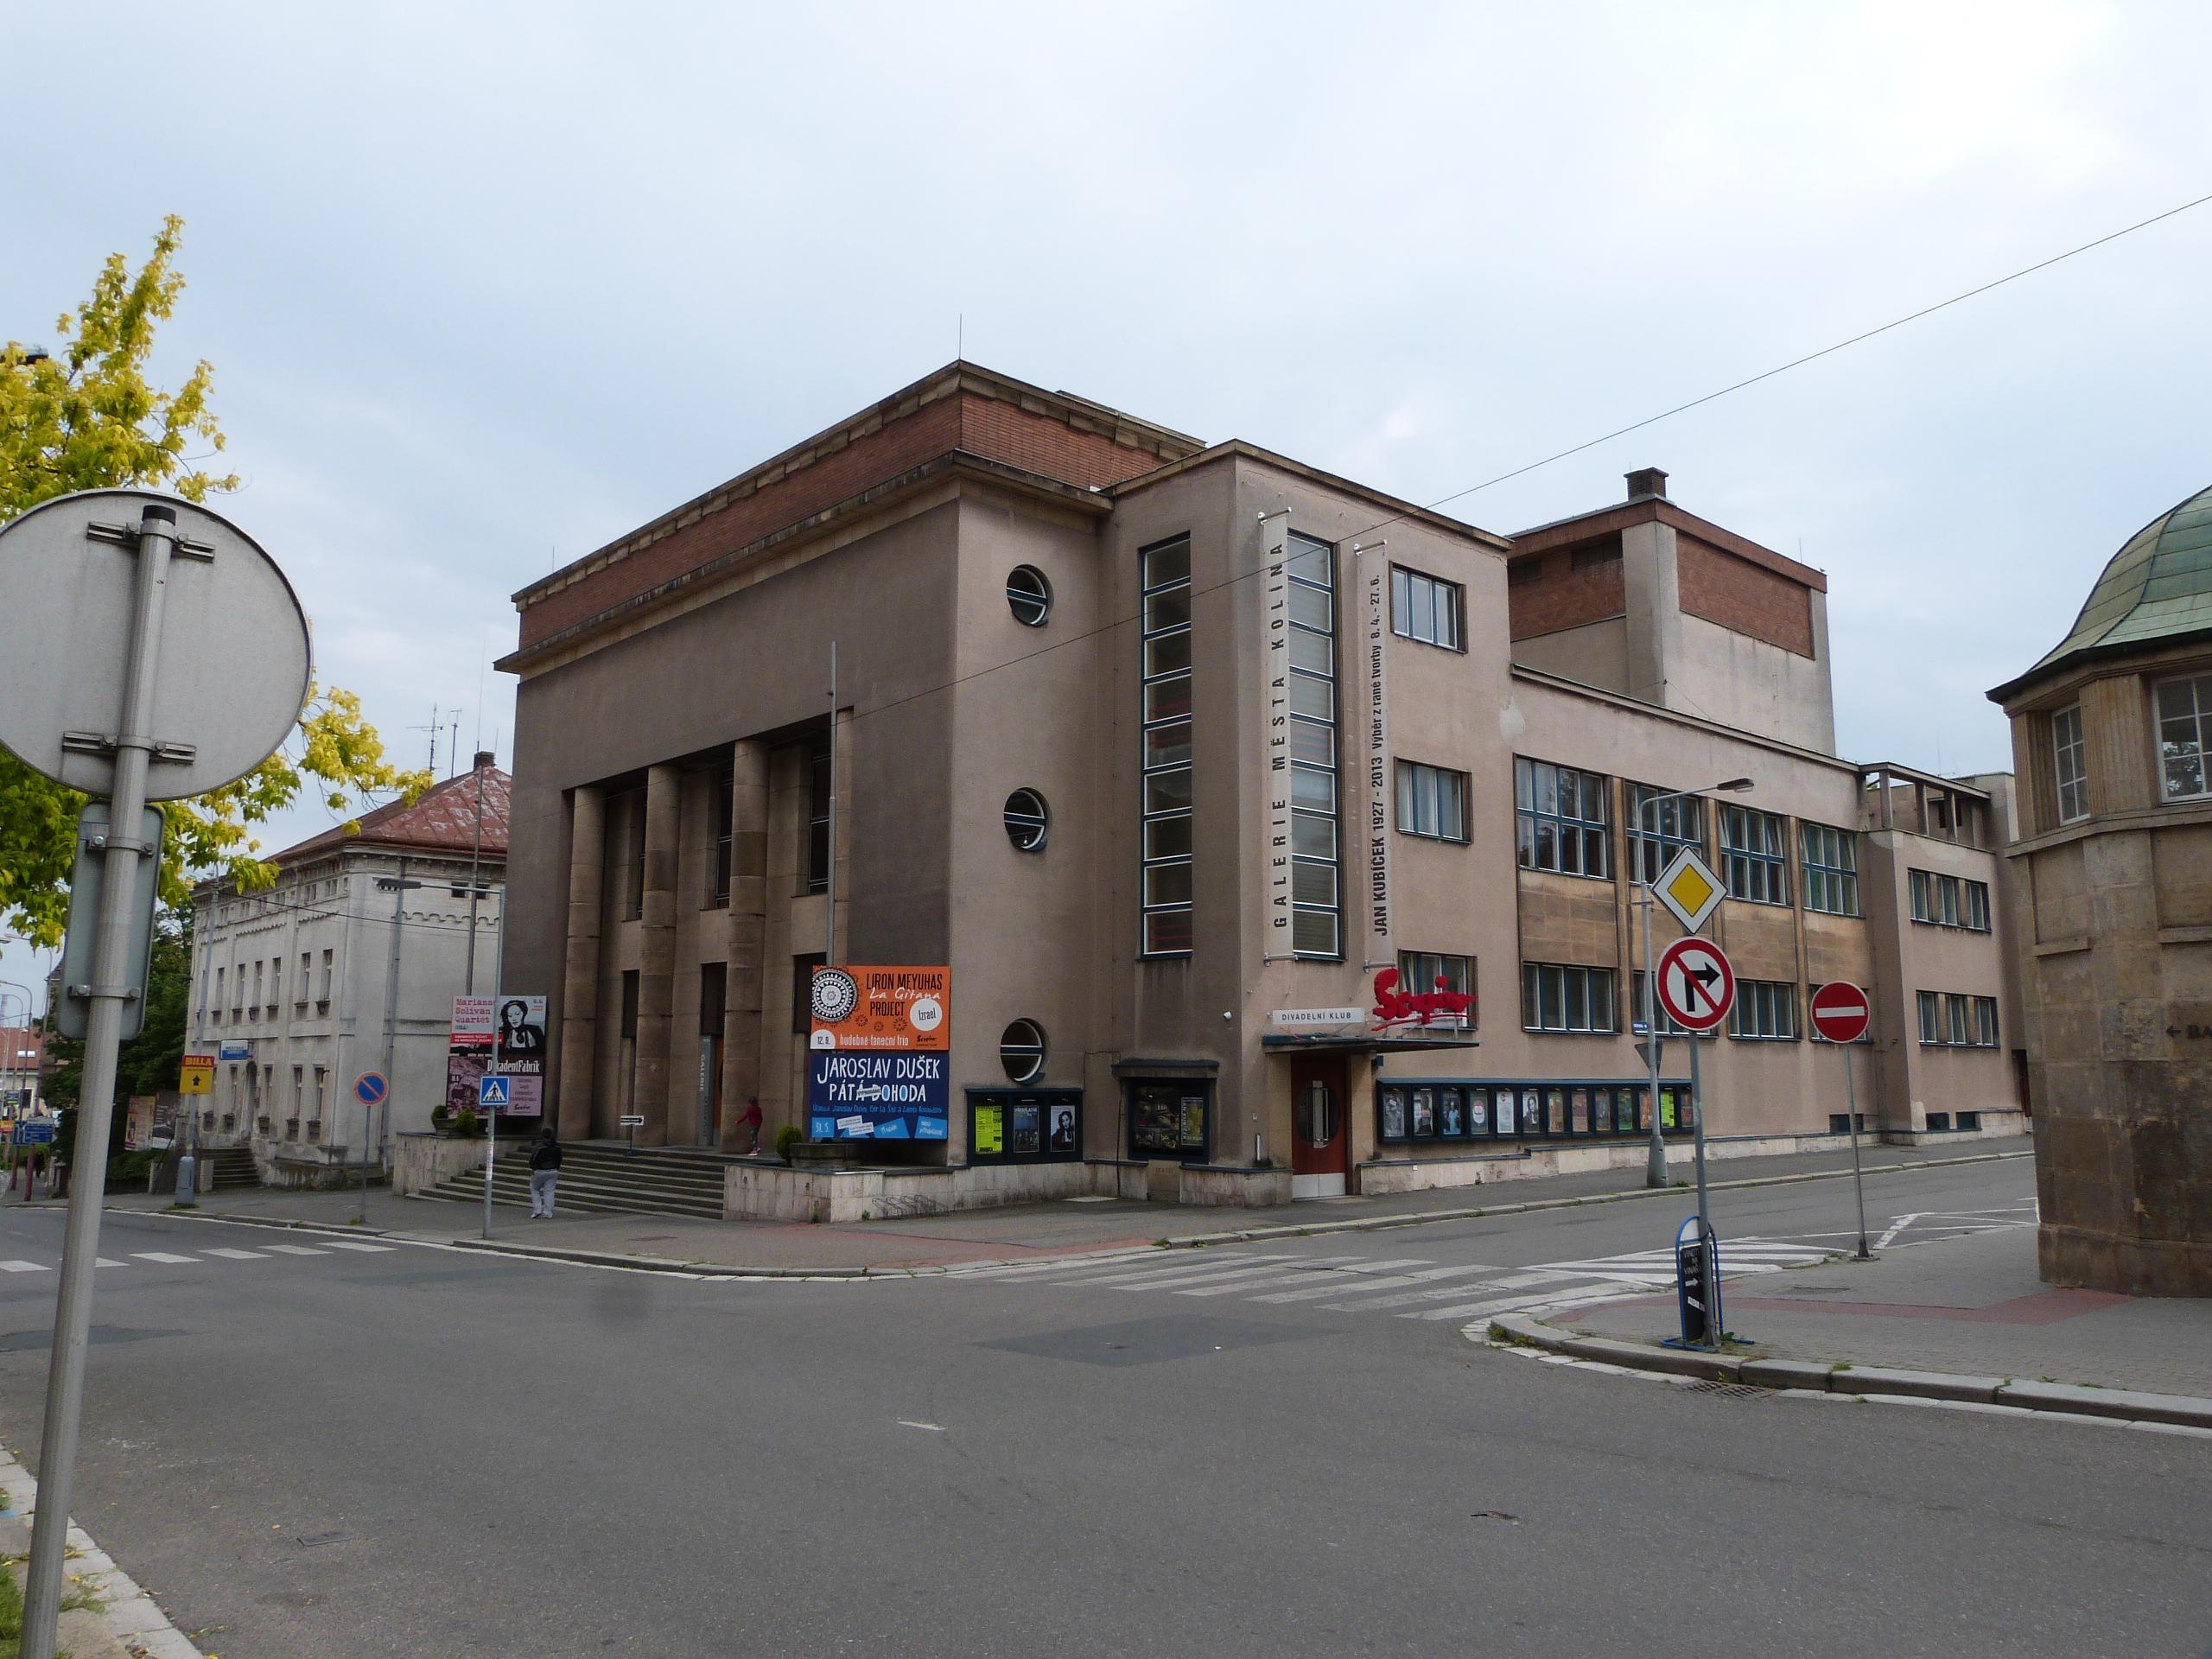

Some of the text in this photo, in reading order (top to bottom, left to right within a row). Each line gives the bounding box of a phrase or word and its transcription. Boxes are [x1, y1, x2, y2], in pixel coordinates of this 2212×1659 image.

[1370, 588, 1380, 605] 27.
[1370, 645, 1382, 680] tvorby
[1370, 681, 1382, 707] rané
[1268, 543, 1287, 928] GALERIE MĚSTA KOLÍNA
[1371, 718, 1383, 750] Výběr
[1370, 756, 1383, 788] 2013
[1371, 800, 1384, 832] 1927
[1370, 836, 1387, 902] KUBÍČEK
[1374, 906, 1388, 937] JAN
[866, 973, 943, 990] LIRON MEYUHAS
[868, 988, 887, 1000] La
[869, 1001, 906, 1017] PROJECT
[918, 1007, 937, 1021] Izrael
[1281, 1012, 1352, 1021] DIVADELNÍ KLUB
[455, 1015, 490, 1024] Quartet
[897, 1033, 909, 1046] trio
[185, 1057, 212, 1065] BILLA
[817, 1055, 940, 1084] JAROSLAV DUŠEK
[871, 1084, 926, 1102] DOHODA
